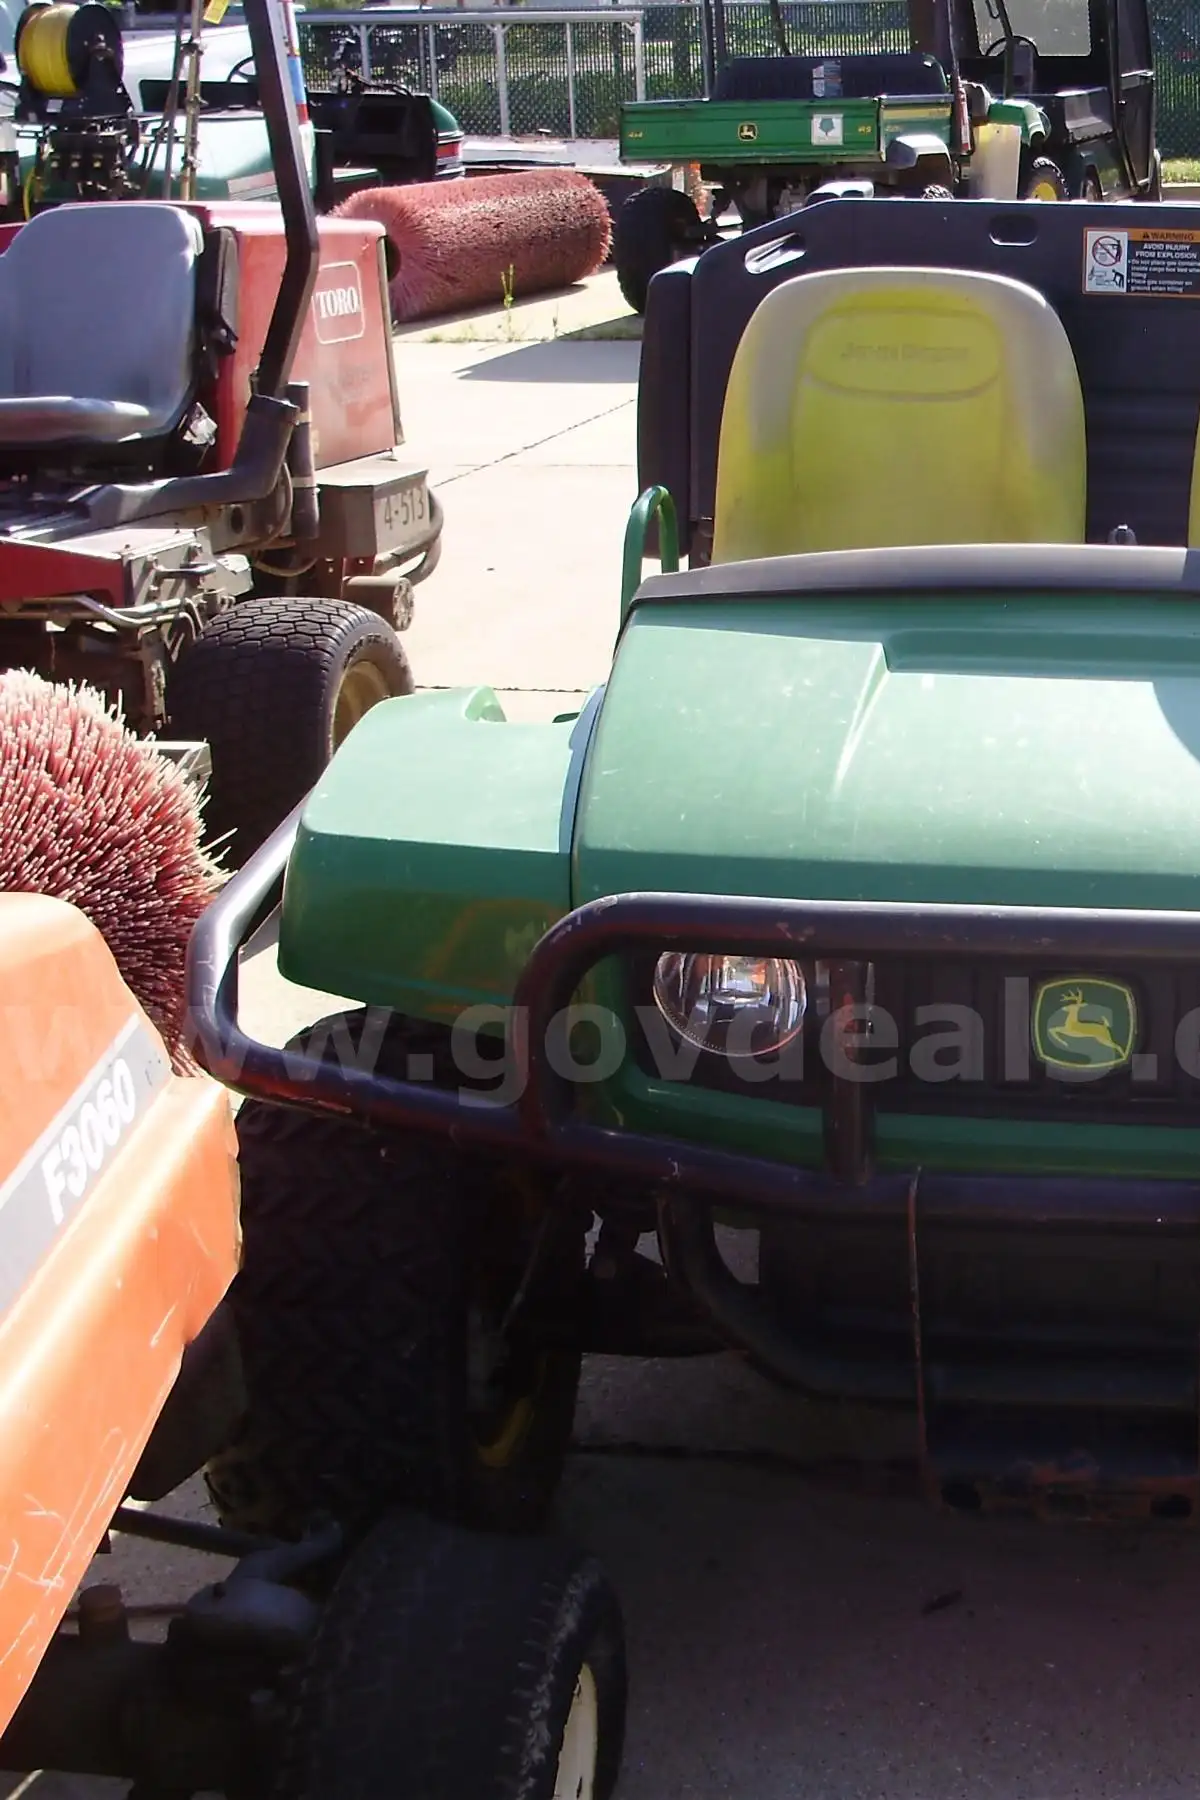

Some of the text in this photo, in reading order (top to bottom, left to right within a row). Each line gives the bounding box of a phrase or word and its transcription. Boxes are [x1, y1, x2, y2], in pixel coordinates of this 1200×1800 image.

[1151, 231, 1195, 241] WARNING
[316, 286, 358, 319] TORO
[42, 1058, 135, 1225] F3060
